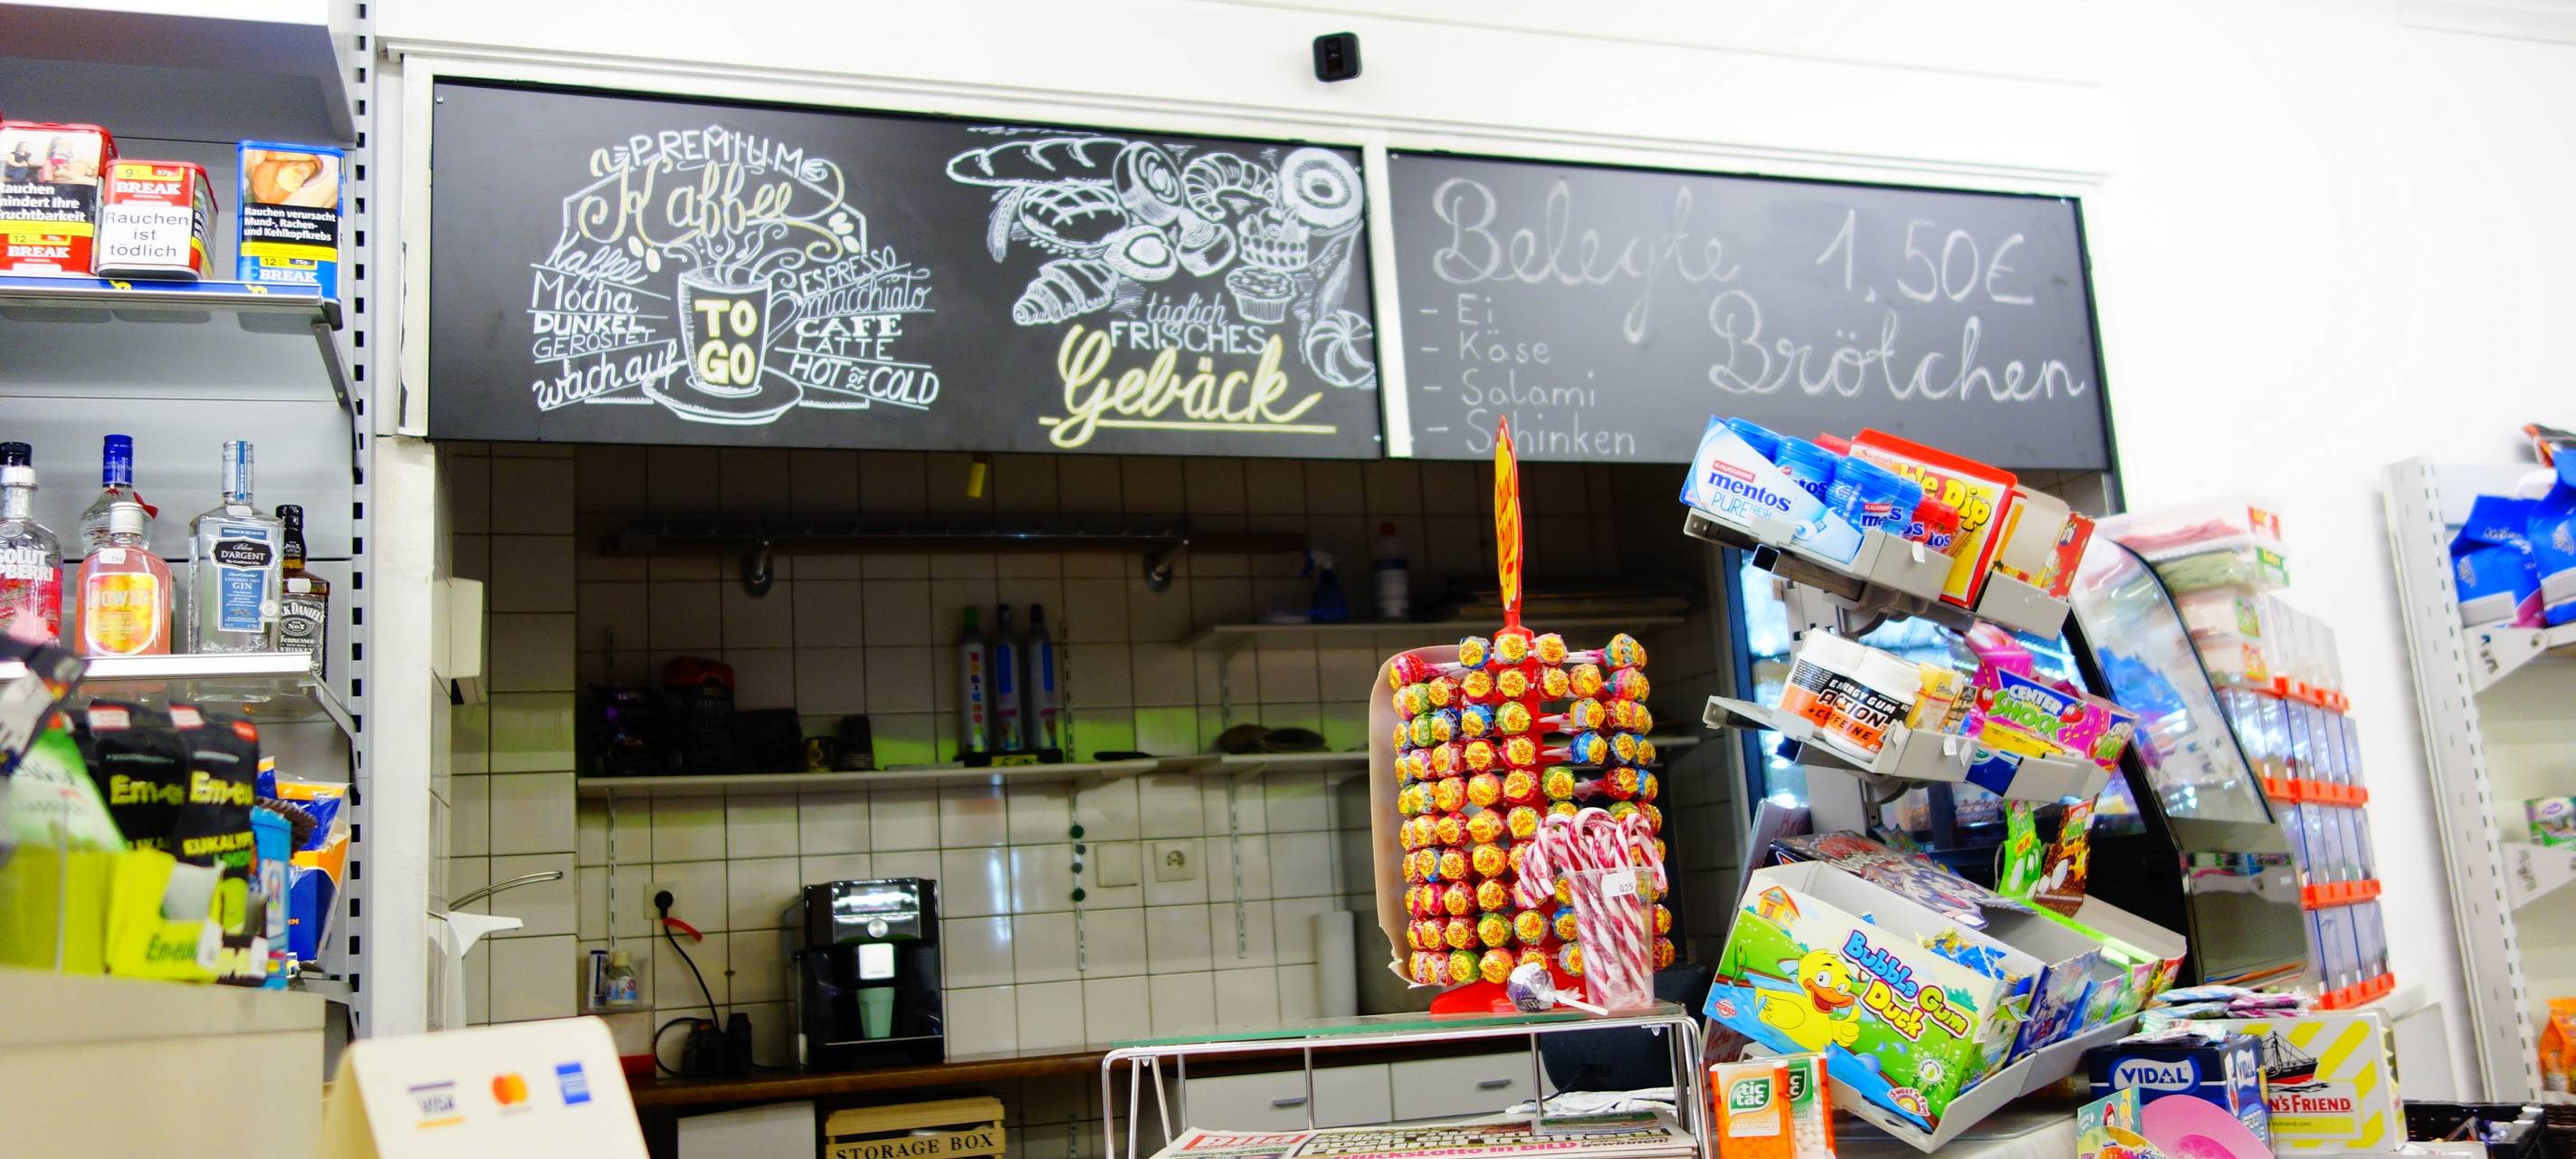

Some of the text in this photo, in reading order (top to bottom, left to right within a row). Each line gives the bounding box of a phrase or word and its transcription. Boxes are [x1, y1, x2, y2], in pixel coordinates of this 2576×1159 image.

[630, 130, 803, 178] PREMIUM
[52, 196, 80, 209] Ihre
[115, 181, 181, 195] BREAK
[579, 150, 806, 247] Kaffee
[105, 211, 189, 226] Rauchen
[244, 207, 336, 223] Rauchen verursacht
[110, 243, 177, 257] tödlich
[133, 228, 157, 241] ist
[243, 227, 332, 241] und Kehlkopfkrebs
[7, 244, 72, 258] BREAK
[545, 228, 648, 289] Kaffee
[1433, 177, 2034, 343] Belegte 1,50€
[259, 268, 318, 283] BREAK
[799, 245, 896, 297] ESPRESSO
[532, 271, 639, 313] Mocha
[801, 269, 932, 317] macchiato
[532, 312, 646, 336] DUNKEL
[694, 299, 758, 337] TO
[1146, 292, 1229, 334] täglich
[1457, 293, 1493, 325] Ei
[795, 314, 902, 338] CAFE
[1109, 321, 1267, 355] FRISCHES
[797, 336, 894, 361] LATTE
[1459, 329, 1551, 363] Käse
[1709, 290, 2085, 401] Brötchen
[532, 340, 684, 408] wach auf
[697, 339, 756, 386] GO
[789, 354, 853, 388] HOT
[868, 366, 940, 405] COLD
[1050, 324, 1322, 448] Gebäck
[1461, 368, 1596, 407] Salami
[1465, 408, 1636, 455] Shinken
[1708, 472, 1792, 512] mentos
[1711, 491, 1748, 520] PURE
[1944, 477, 1991, 532] Dip
[220, 550, 266, 560] D'ARGENT
[1866, 696, 1896, 714] GUM
[1989, 690, 2066, 740] SHOCK
[2008, 685, 2064, 714] CENTER
[1842, 929, 1969, 1036] Bubble Gum
[1863, 978, 1924, 1039] Duck
[1742, 1081, 1768, 1094] tic
[2121, 1068, 2189, 1084] VIDAL
[419, 1095, 457, 1115] VISA
[1736, 1094, 1765, 1106] tac
[2291, 1094, 2352, 1114] FRIEND
[836, 1132, 994, 1159] STORAGE BOX
